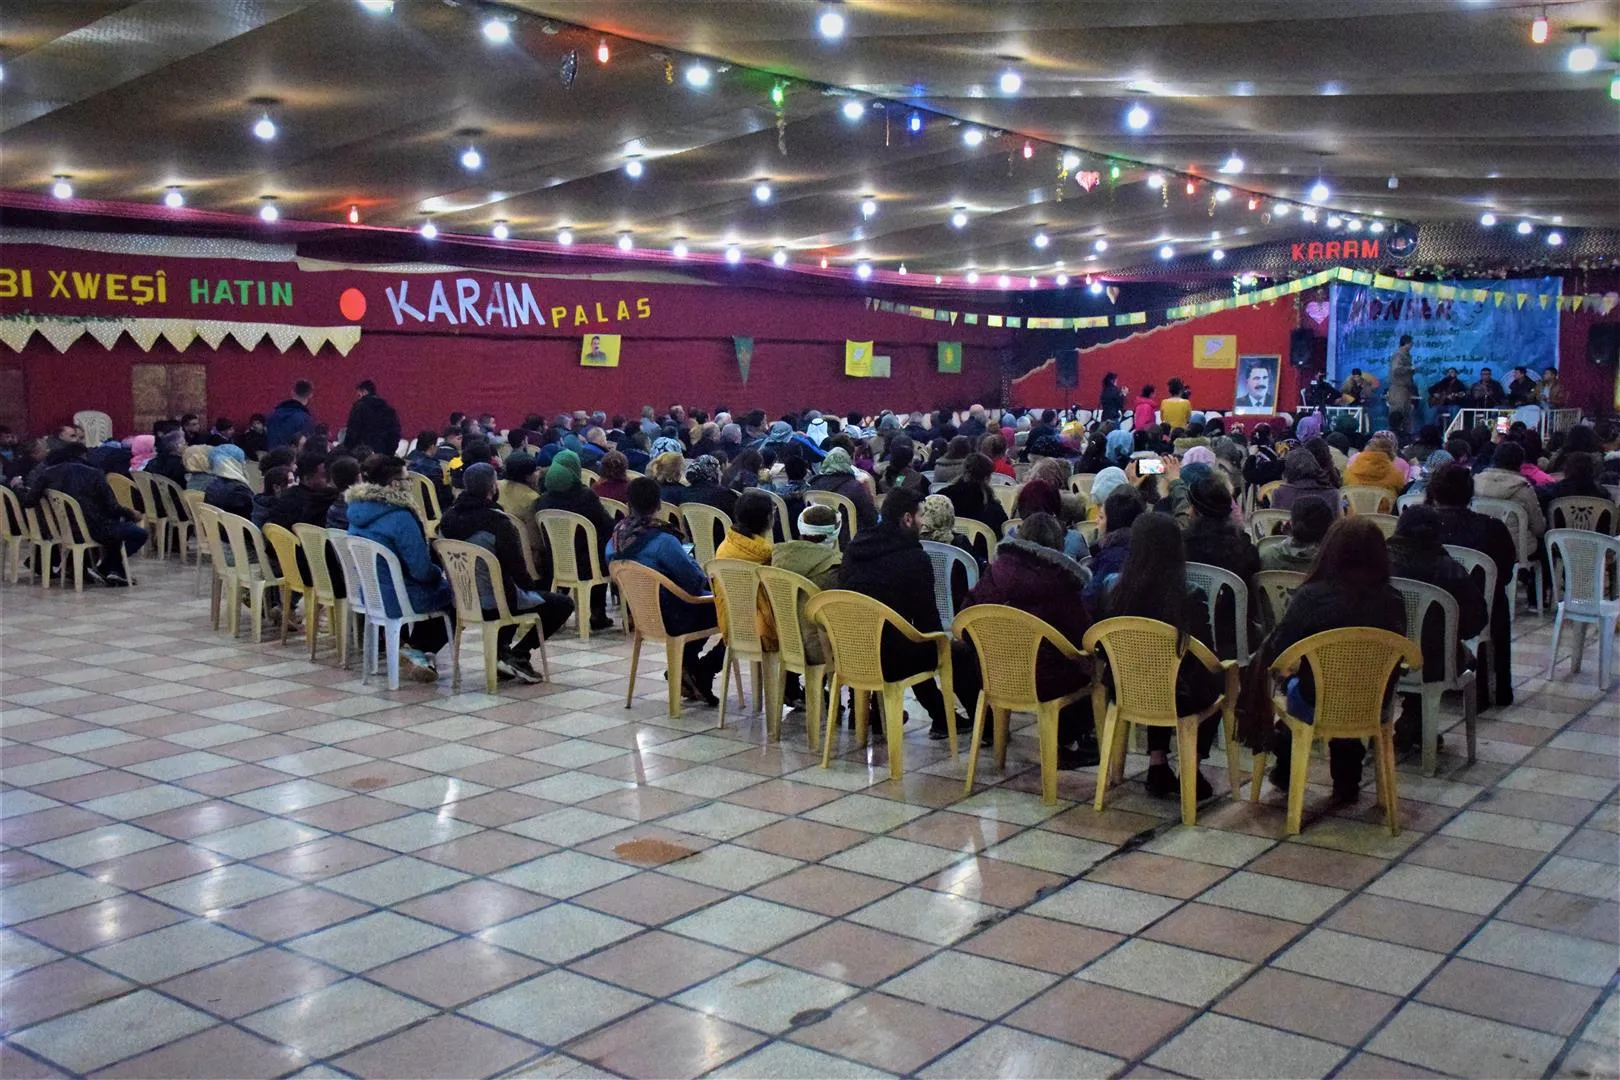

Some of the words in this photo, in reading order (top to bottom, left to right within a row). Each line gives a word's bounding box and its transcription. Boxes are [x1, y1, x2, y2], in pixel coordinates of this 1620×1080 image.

[1291, 239, 1379, 261] KARAM
[48, 270, 167, 305] XWEŞÎ
[190, 278, 293, 306] HATIN
[385, 278, 546, 328] KARAM
[551, 298, 651, 328] PALAS
